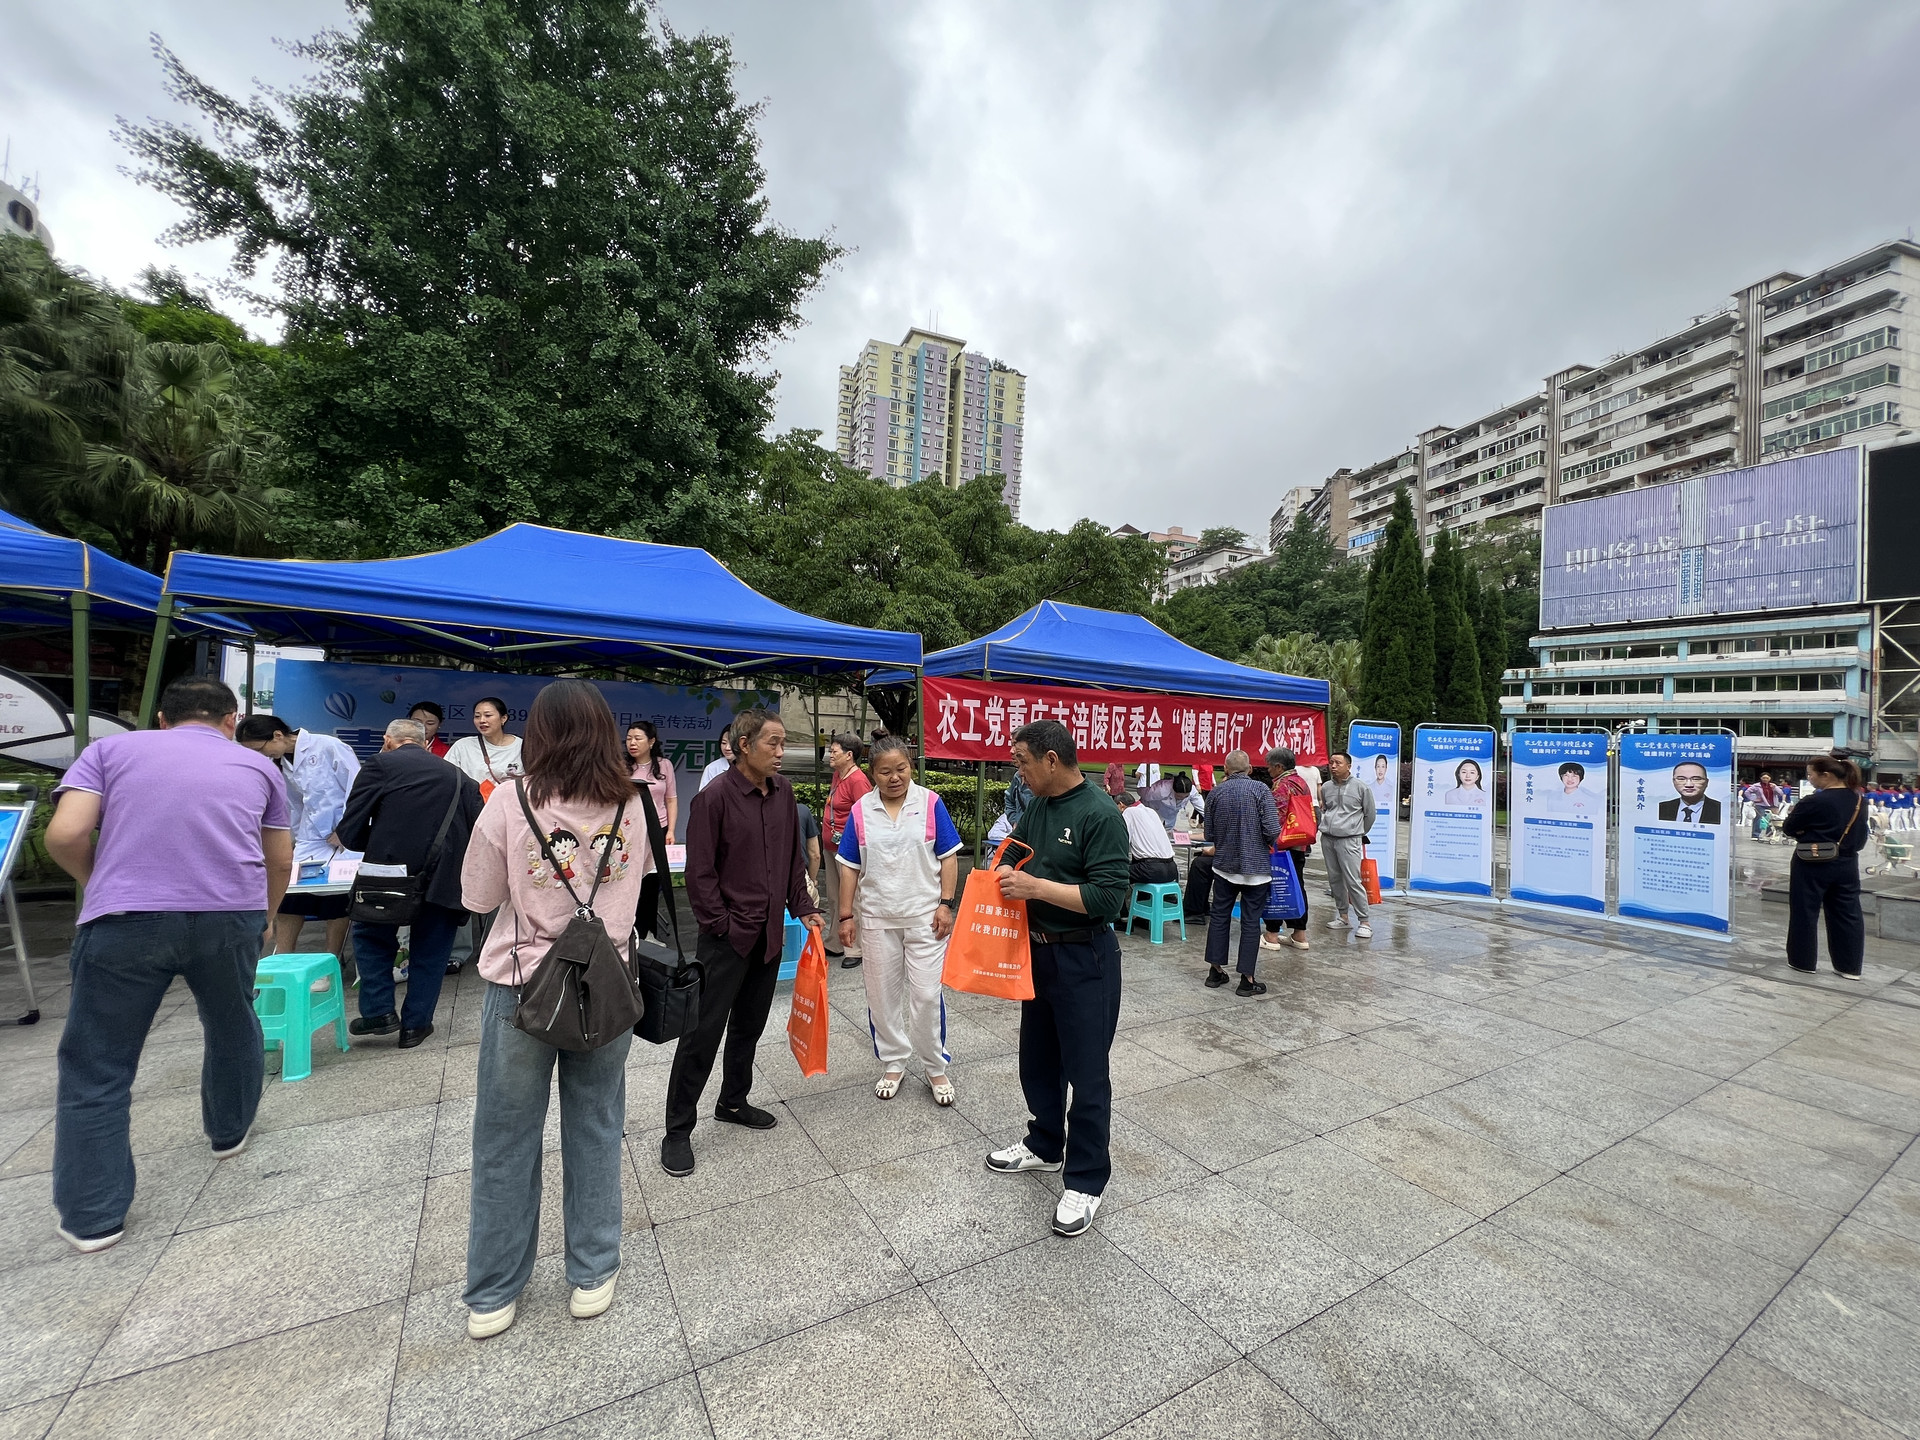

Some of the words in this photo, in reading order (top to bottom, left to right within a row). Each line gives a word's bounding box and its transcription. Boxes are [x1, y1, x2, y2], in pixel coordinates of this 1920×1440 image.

[651, 713, 712, 731] 宣传活动
[1259, 715, 1316, 755] 义诊活动
[1634, 742, 1716, 750] 农工党重庆市涪陵区委会
[1526, 773, 1534, 803] 专家简介
[1636, 778, 1646, 811] 专家简介
